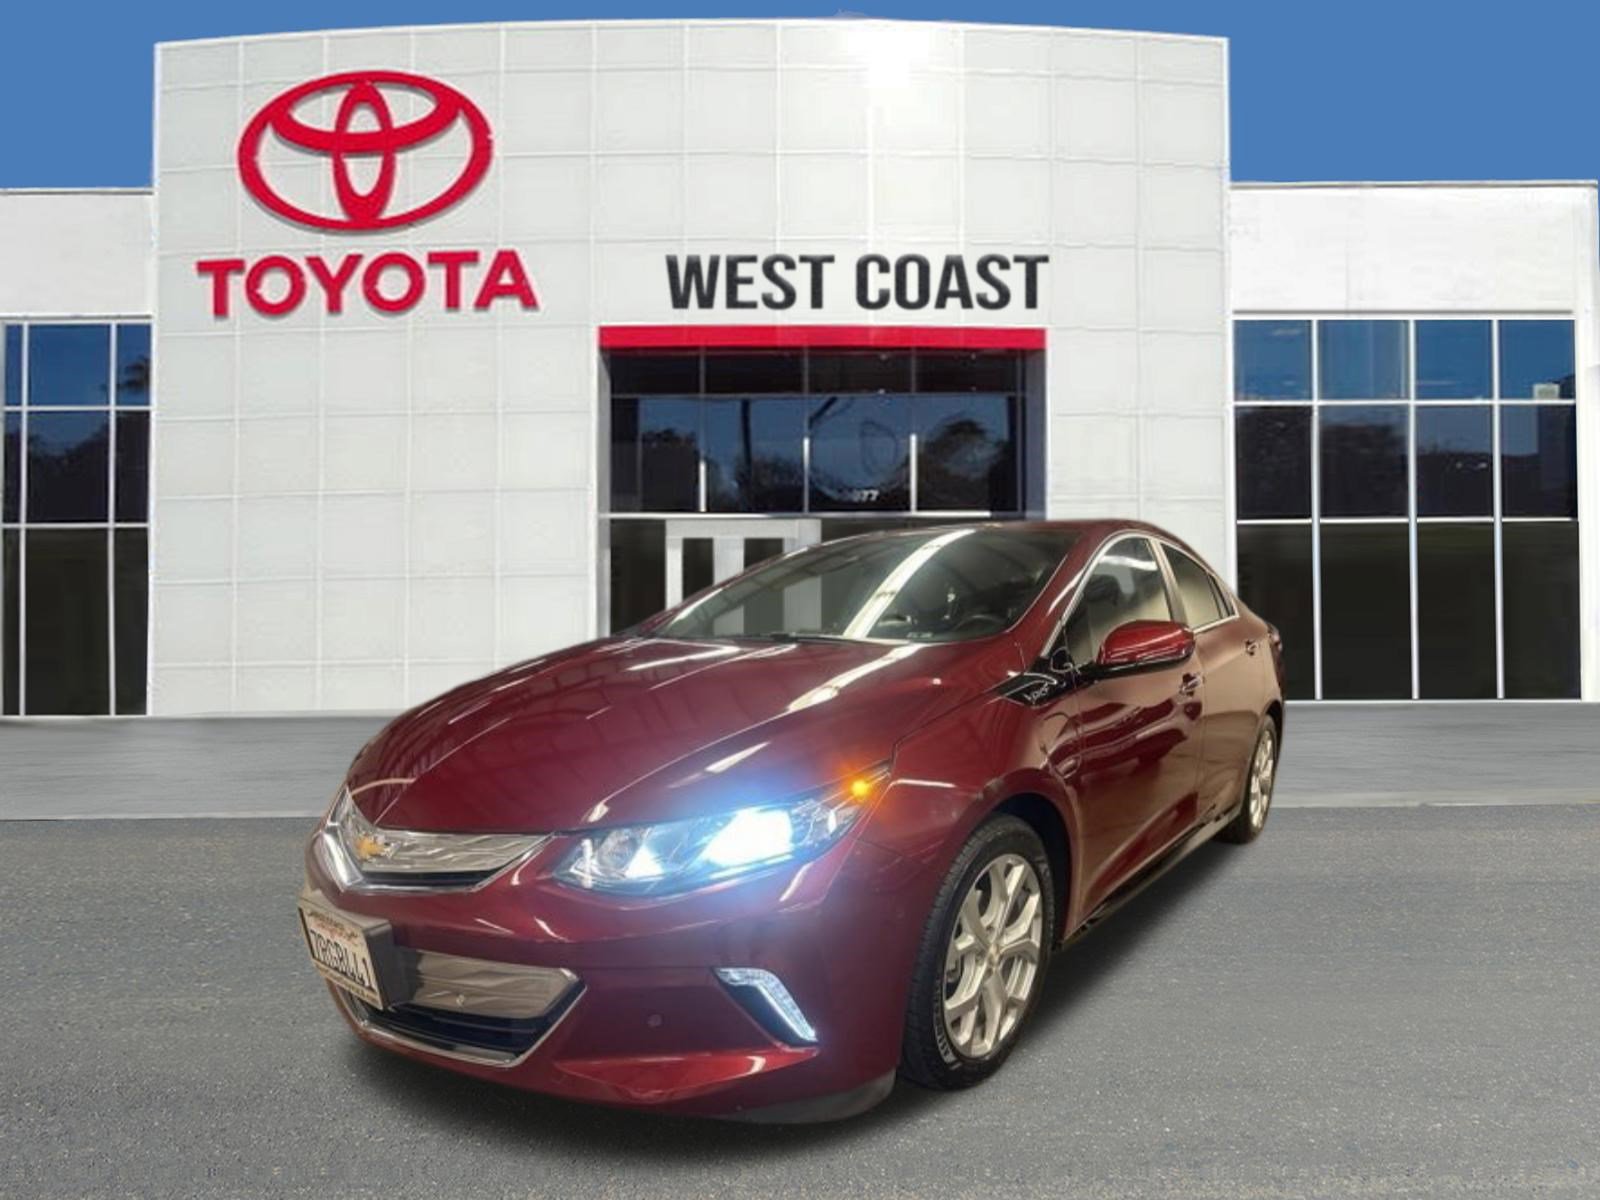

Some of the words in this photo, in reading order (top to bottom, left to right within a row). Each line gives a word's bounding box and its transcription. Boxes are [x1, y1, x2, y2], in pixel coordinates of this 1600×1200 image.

[196, 250, 539, 317] TOYOTA
[665, 254, 835, 310] WEST
[855, 254, 1049, 310] COAST
